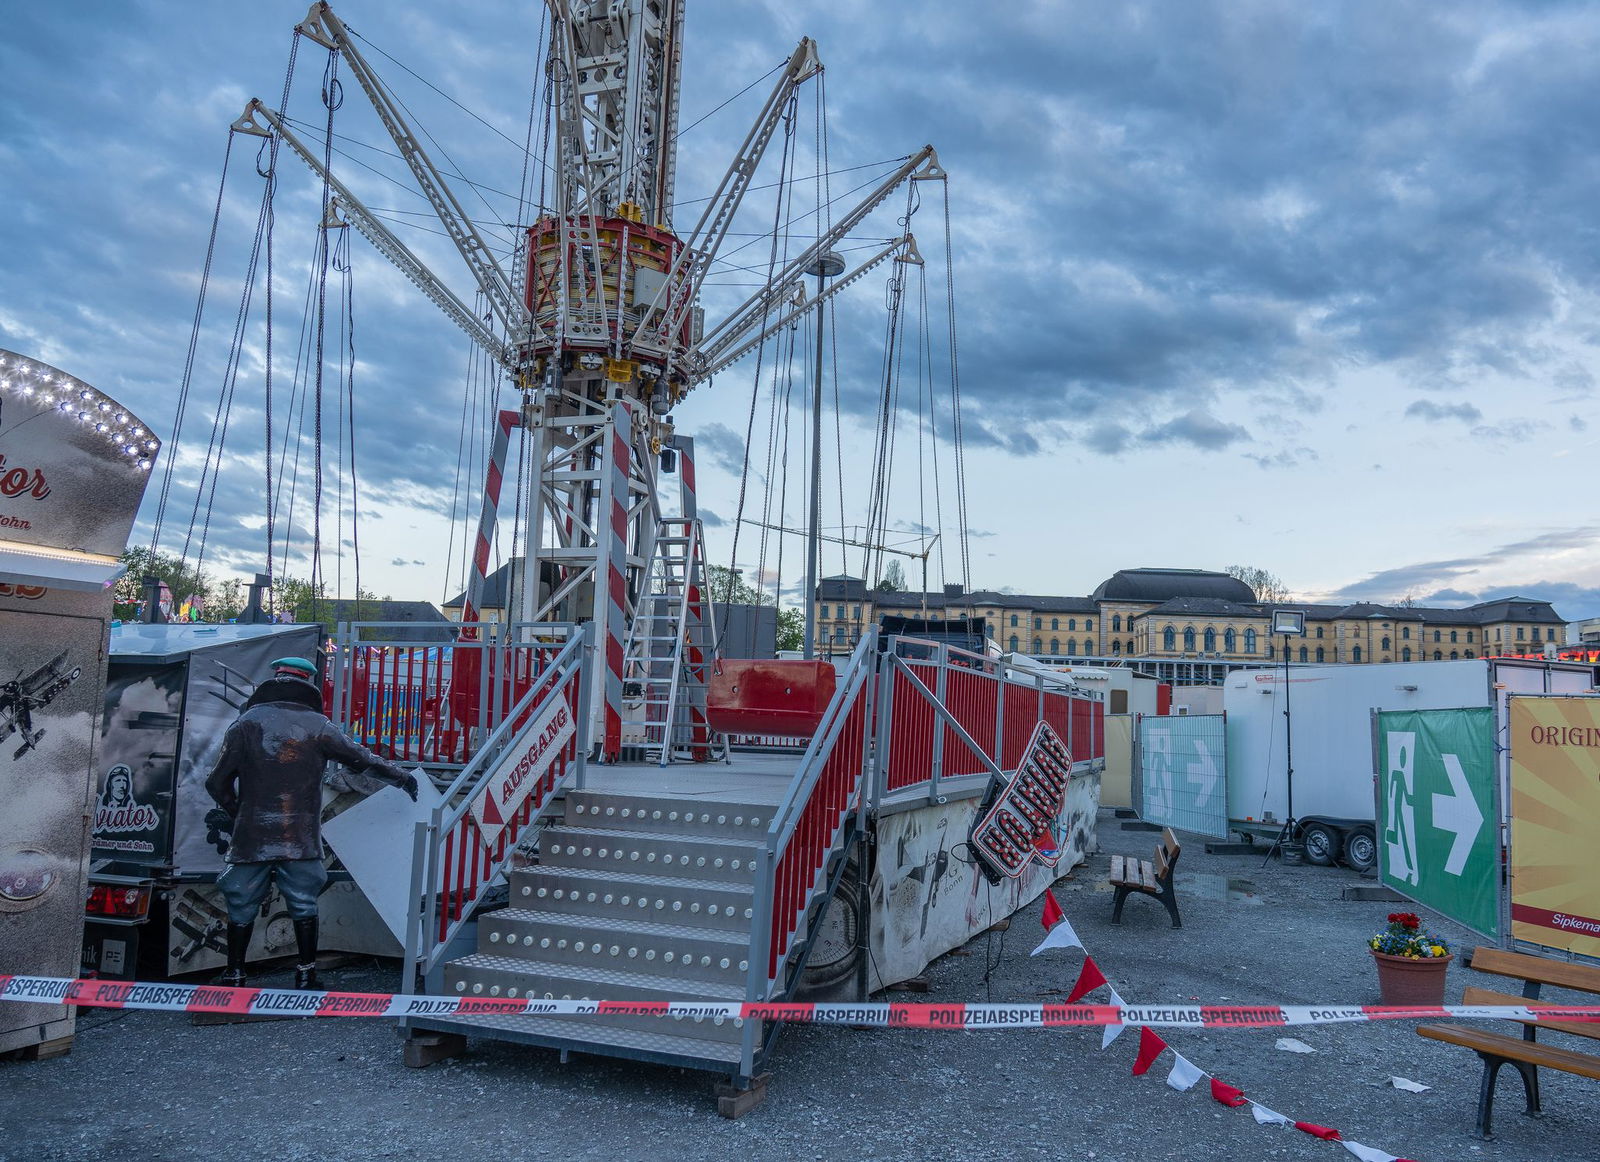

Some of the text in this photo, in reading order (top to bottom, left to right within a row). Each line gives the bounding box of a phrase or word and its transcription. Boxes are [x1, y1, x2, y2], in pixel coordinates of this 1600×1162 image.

[0, 515, 31, 530] ohn
[502, 706, 568, 805] AUSGANG
[95, 801, 157, 831] viator
[116, 840, 132, 850] und
[133, 841, 154, 852] Sohn
[96, 984, 234, 1006] POLIZEIABSPERRUNG
[246, 993, 393, 1013] POLIZEIABSPERRUNG
[929, 1009, 1095, 1025] POLIZEIABSPERRUNG
[1116, 1010, 1290, 1024] POLIZEIABSPERRUNG
